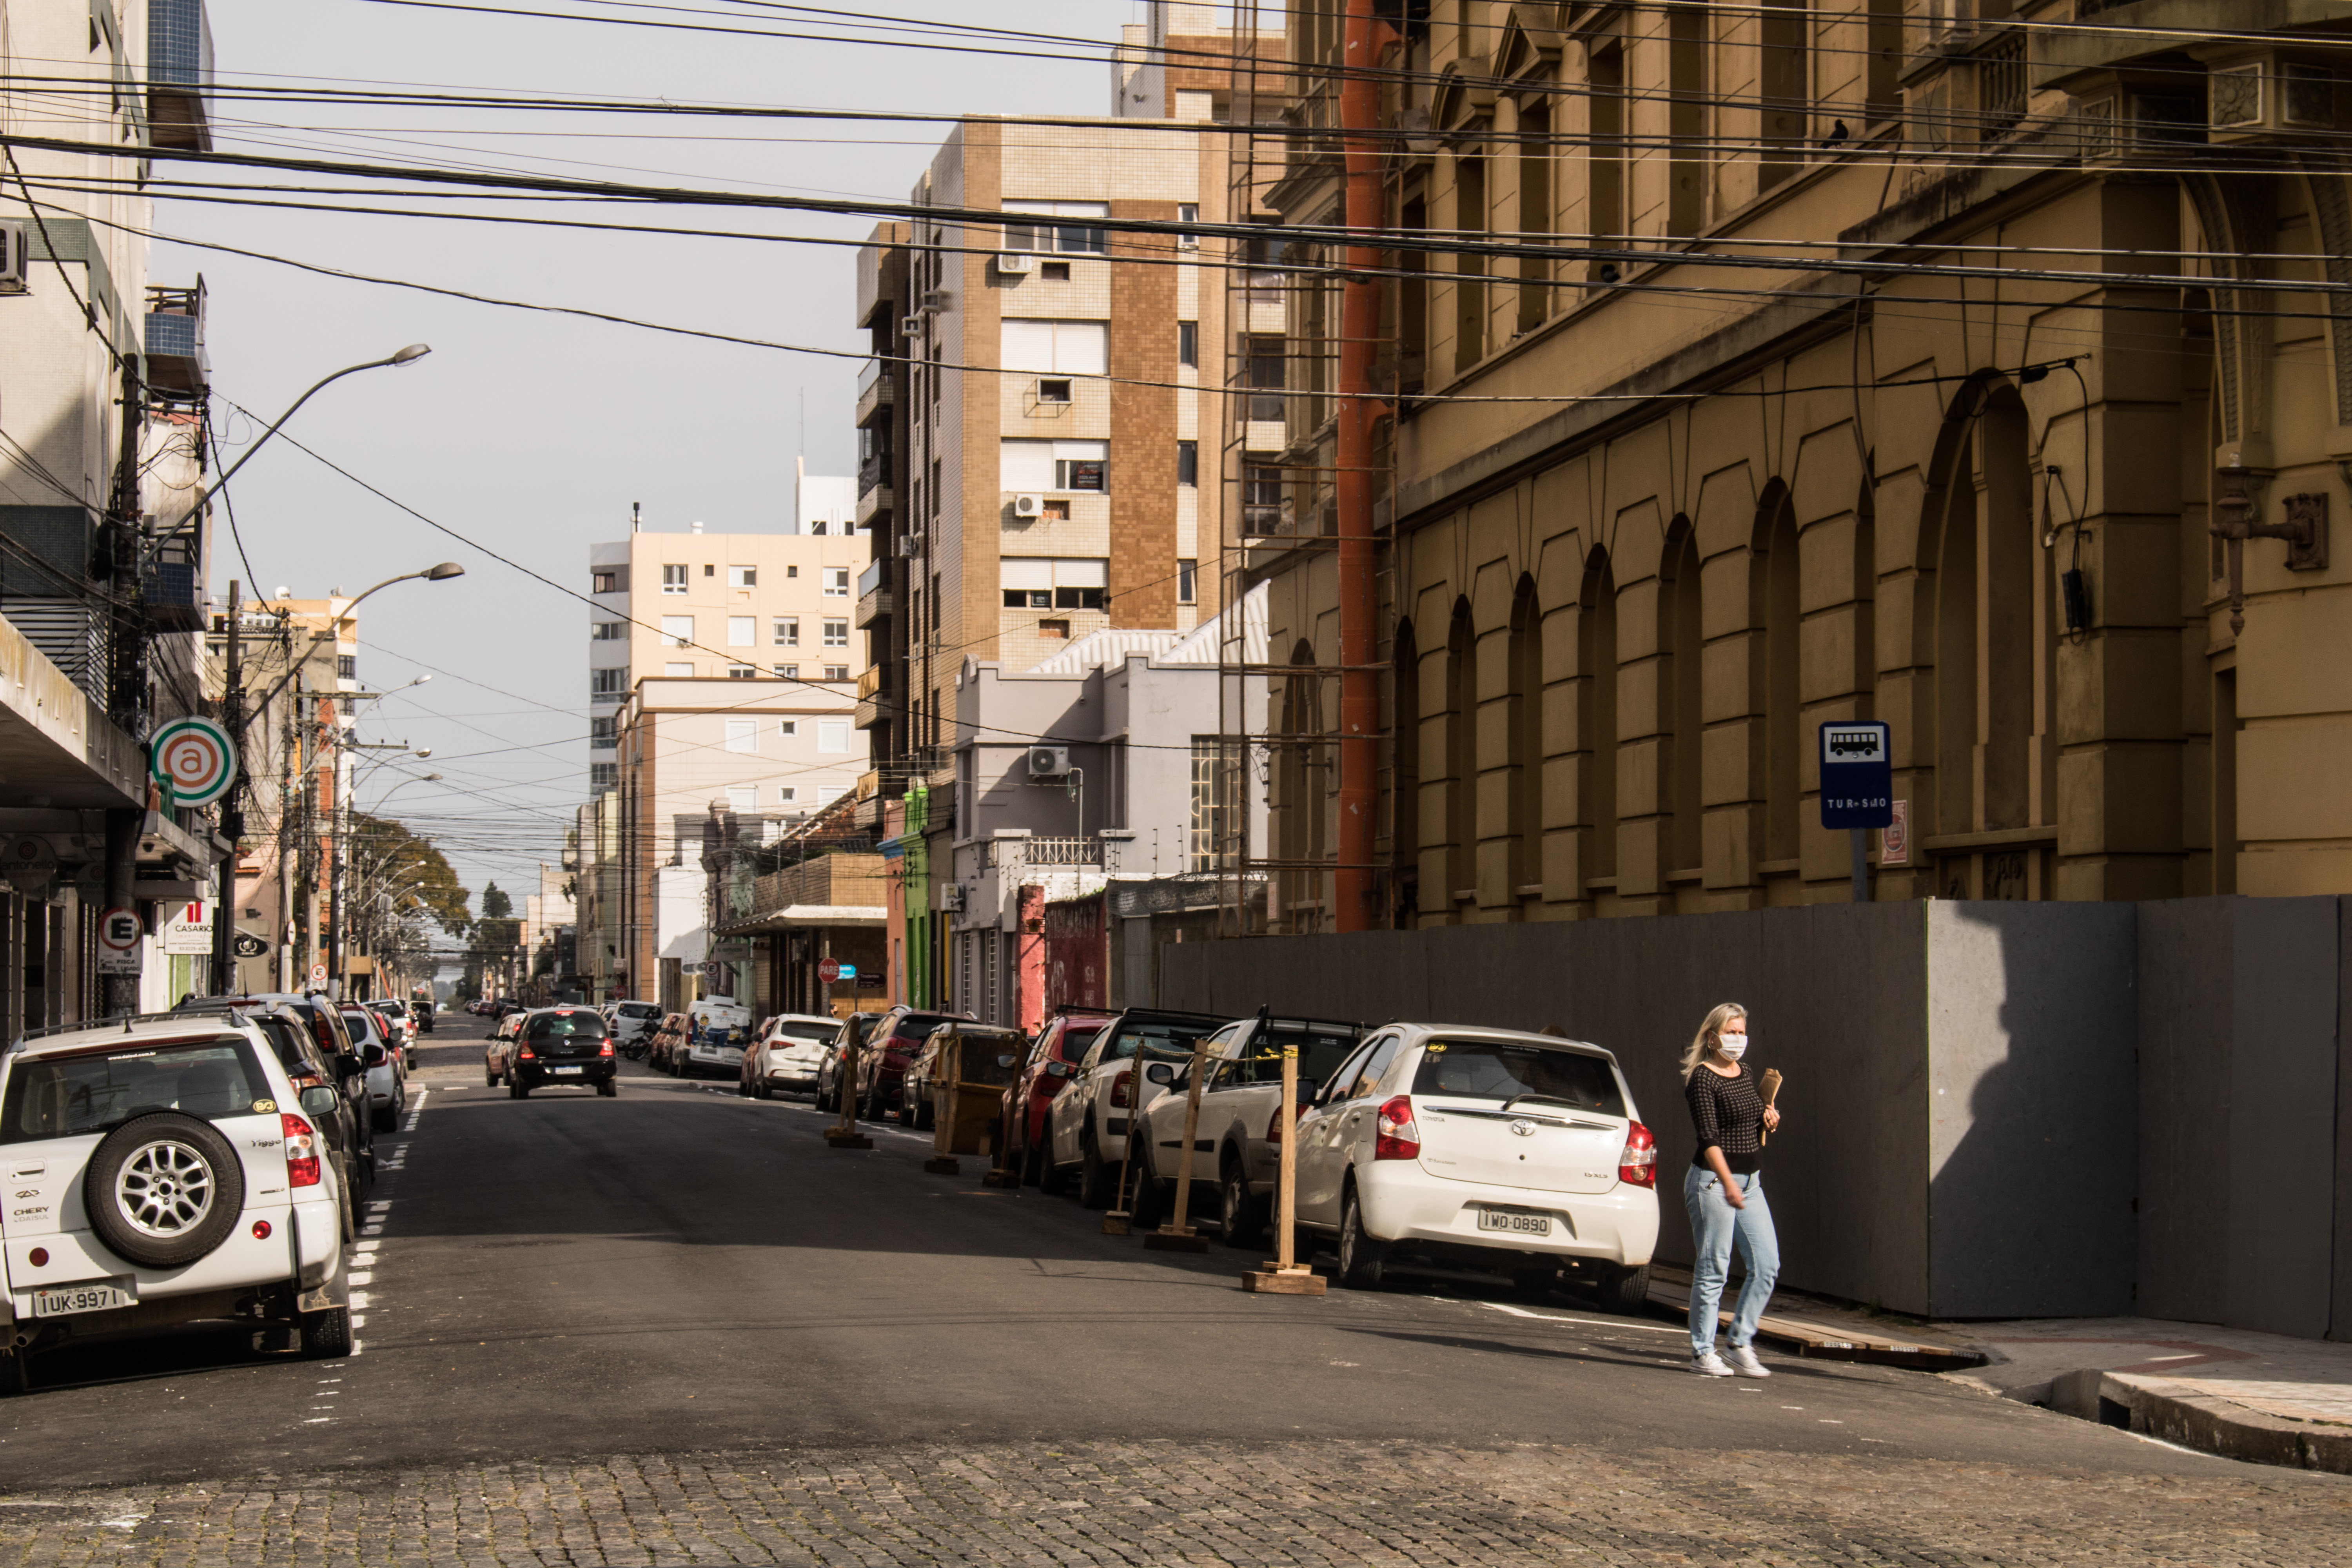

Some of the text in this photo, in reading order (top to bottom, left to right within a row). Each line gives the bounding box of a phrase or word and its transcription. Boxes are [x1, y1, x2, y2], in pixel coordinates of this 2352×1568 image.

[180, 748, 201, 774] a
[1828, 798, 1886, 808] TURSMO
[2, 859, 54, 870] antonello
[111, 918, 133, 939] E
[820, 965, 838, 975] PARE
[251, 1139, 283, 1147] Tiggo
[14, 1206, 49, 1216] CHERY
